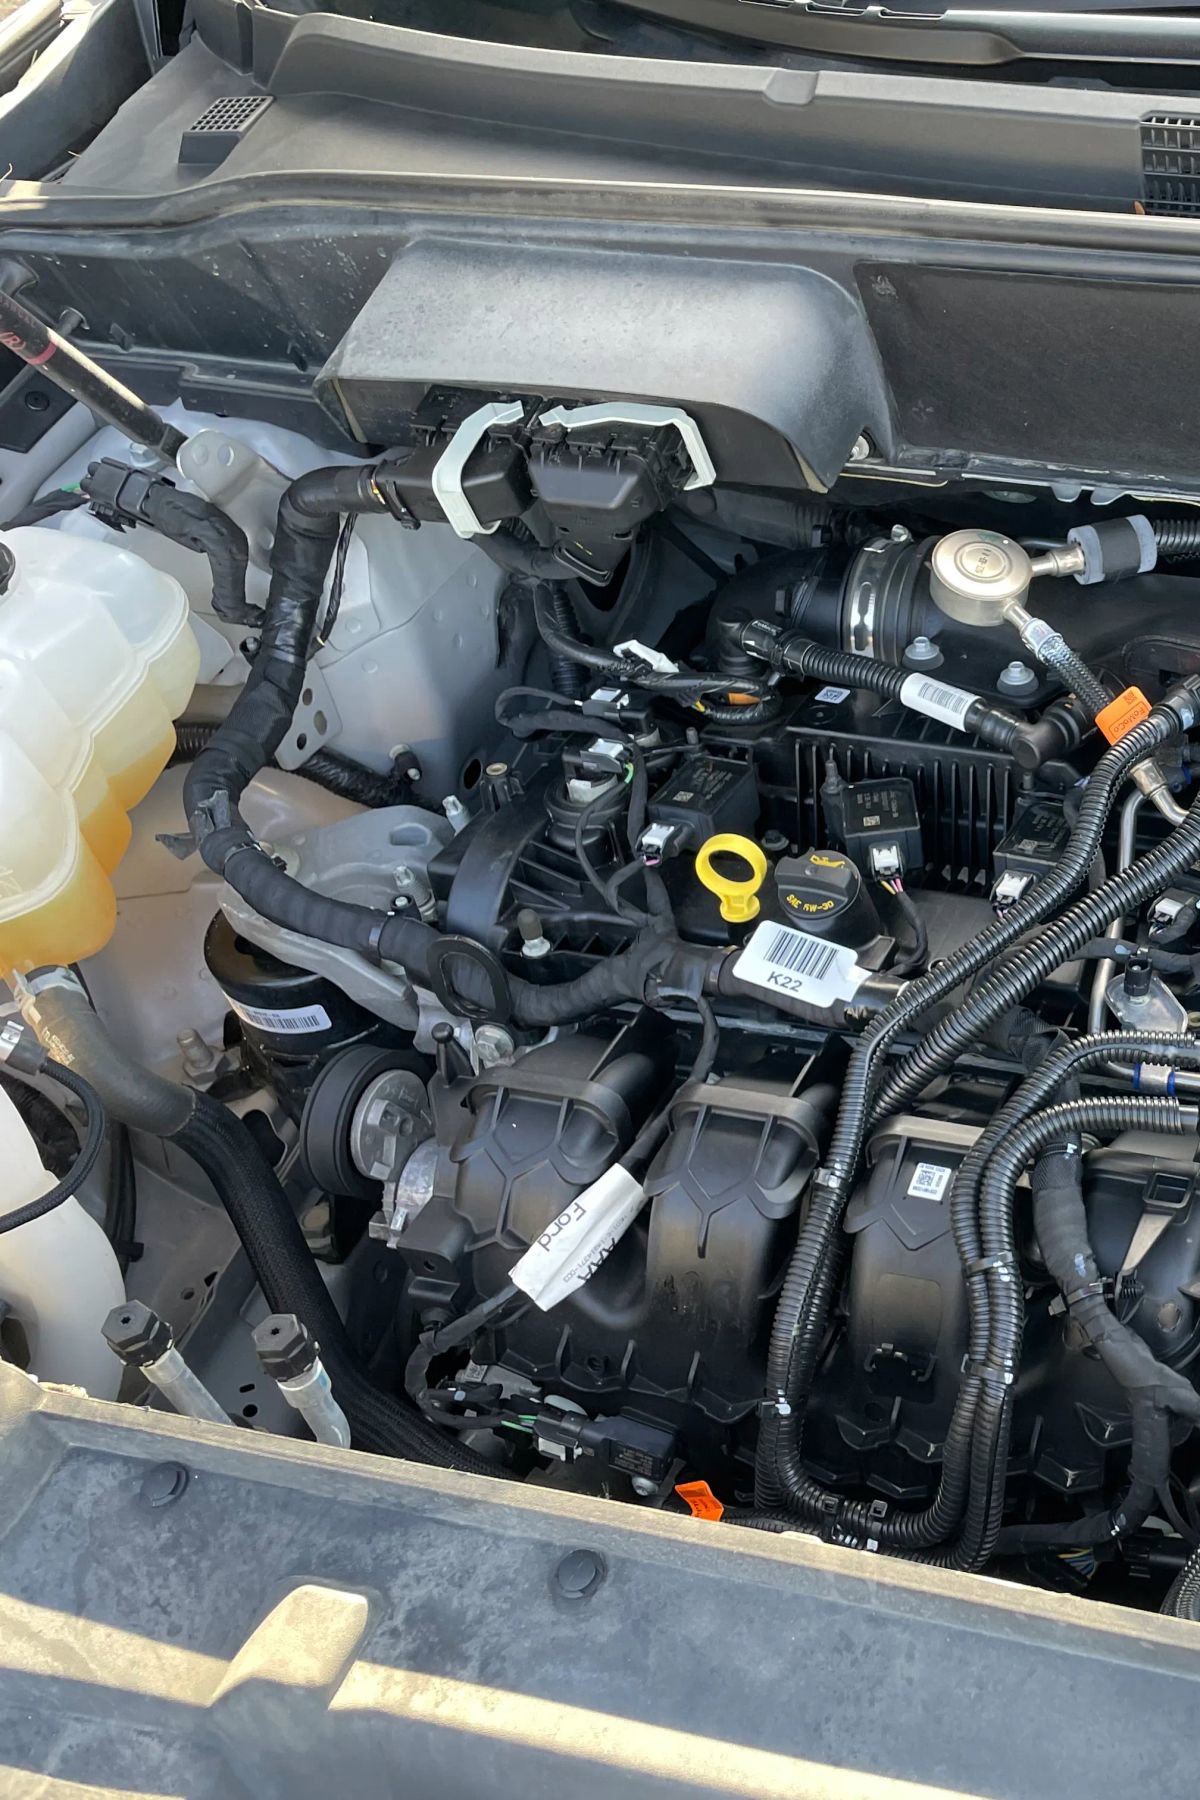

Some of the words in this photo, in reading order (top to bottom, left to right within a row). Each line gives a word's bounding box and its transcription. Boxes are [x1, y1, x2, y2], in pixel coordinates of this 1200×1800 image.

[786, 894, 801, 908] SAE
[767, 971, 803, 992] K22
[537, 1202, 587, 1252] Ford
